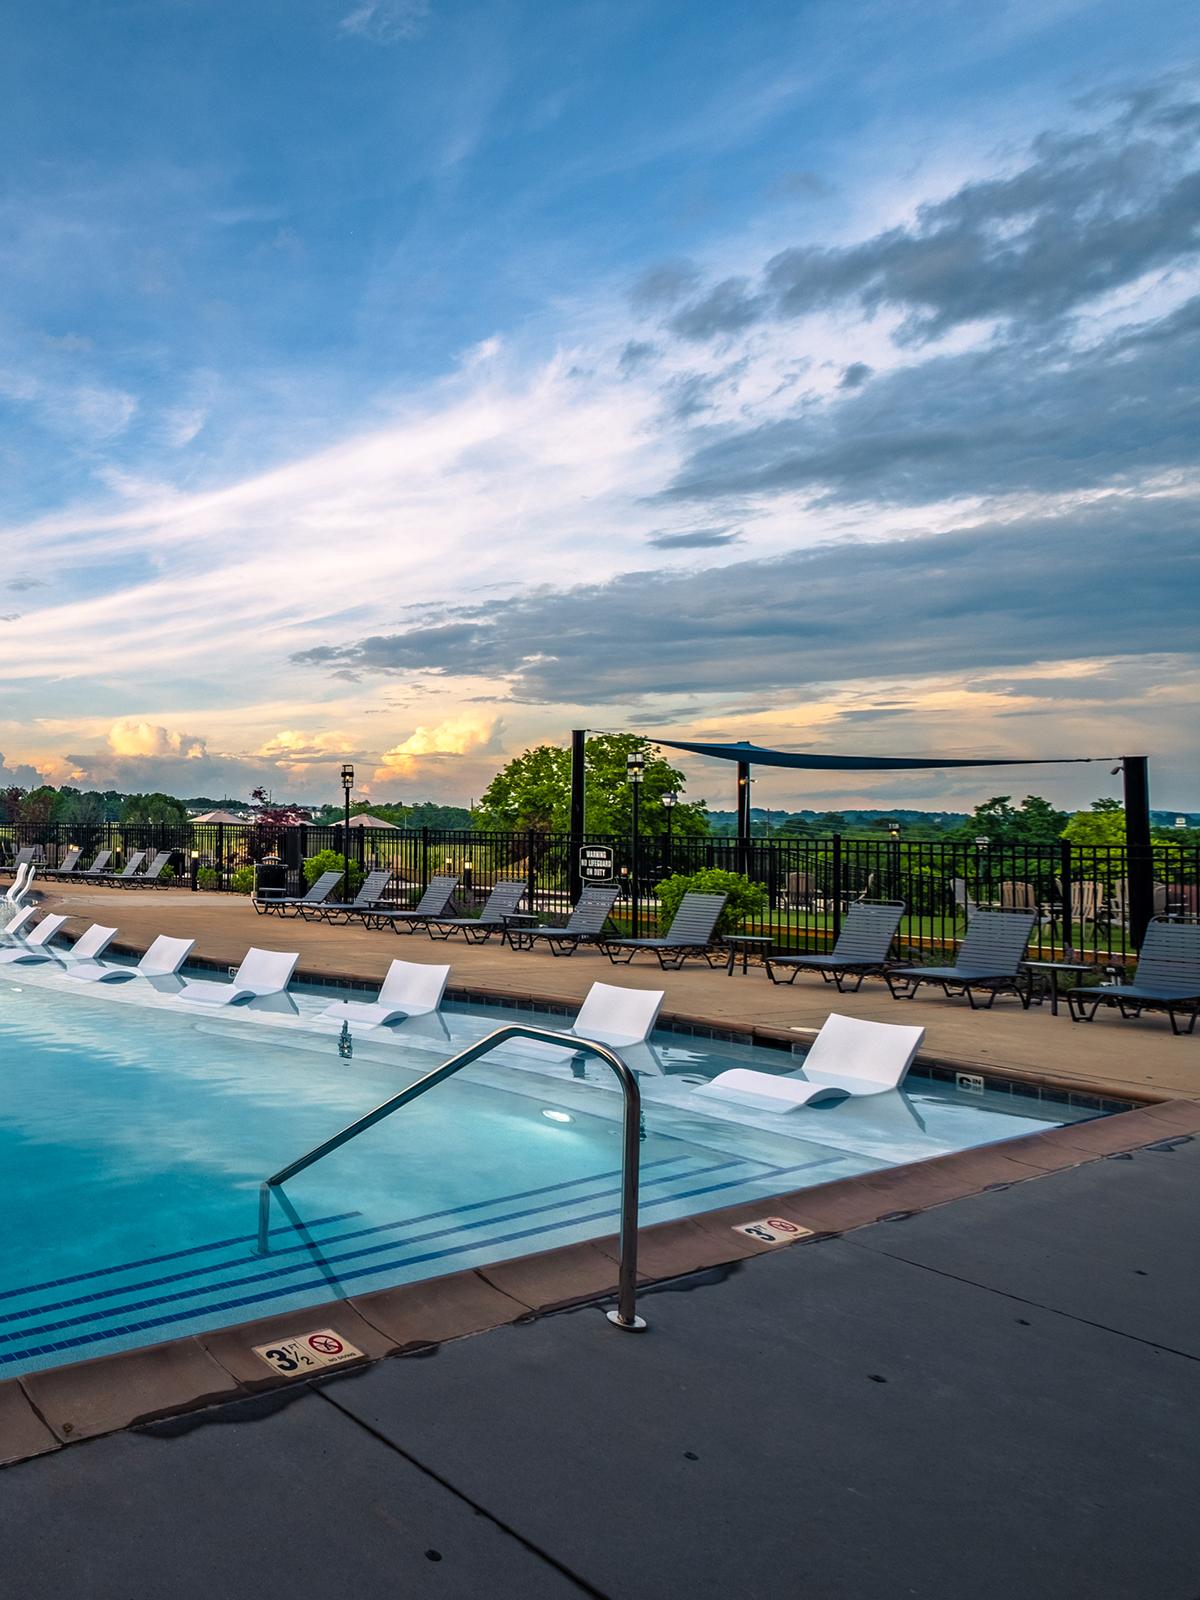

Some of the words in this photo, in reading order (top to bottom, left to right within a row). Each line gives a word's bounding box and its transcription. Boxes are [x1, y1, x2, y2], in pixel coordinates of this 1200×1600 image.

[745, 1228, 776, 1241] 3
[265, 1349, 298, 1371] 3
[288, 1343, 300, 1351] FT
